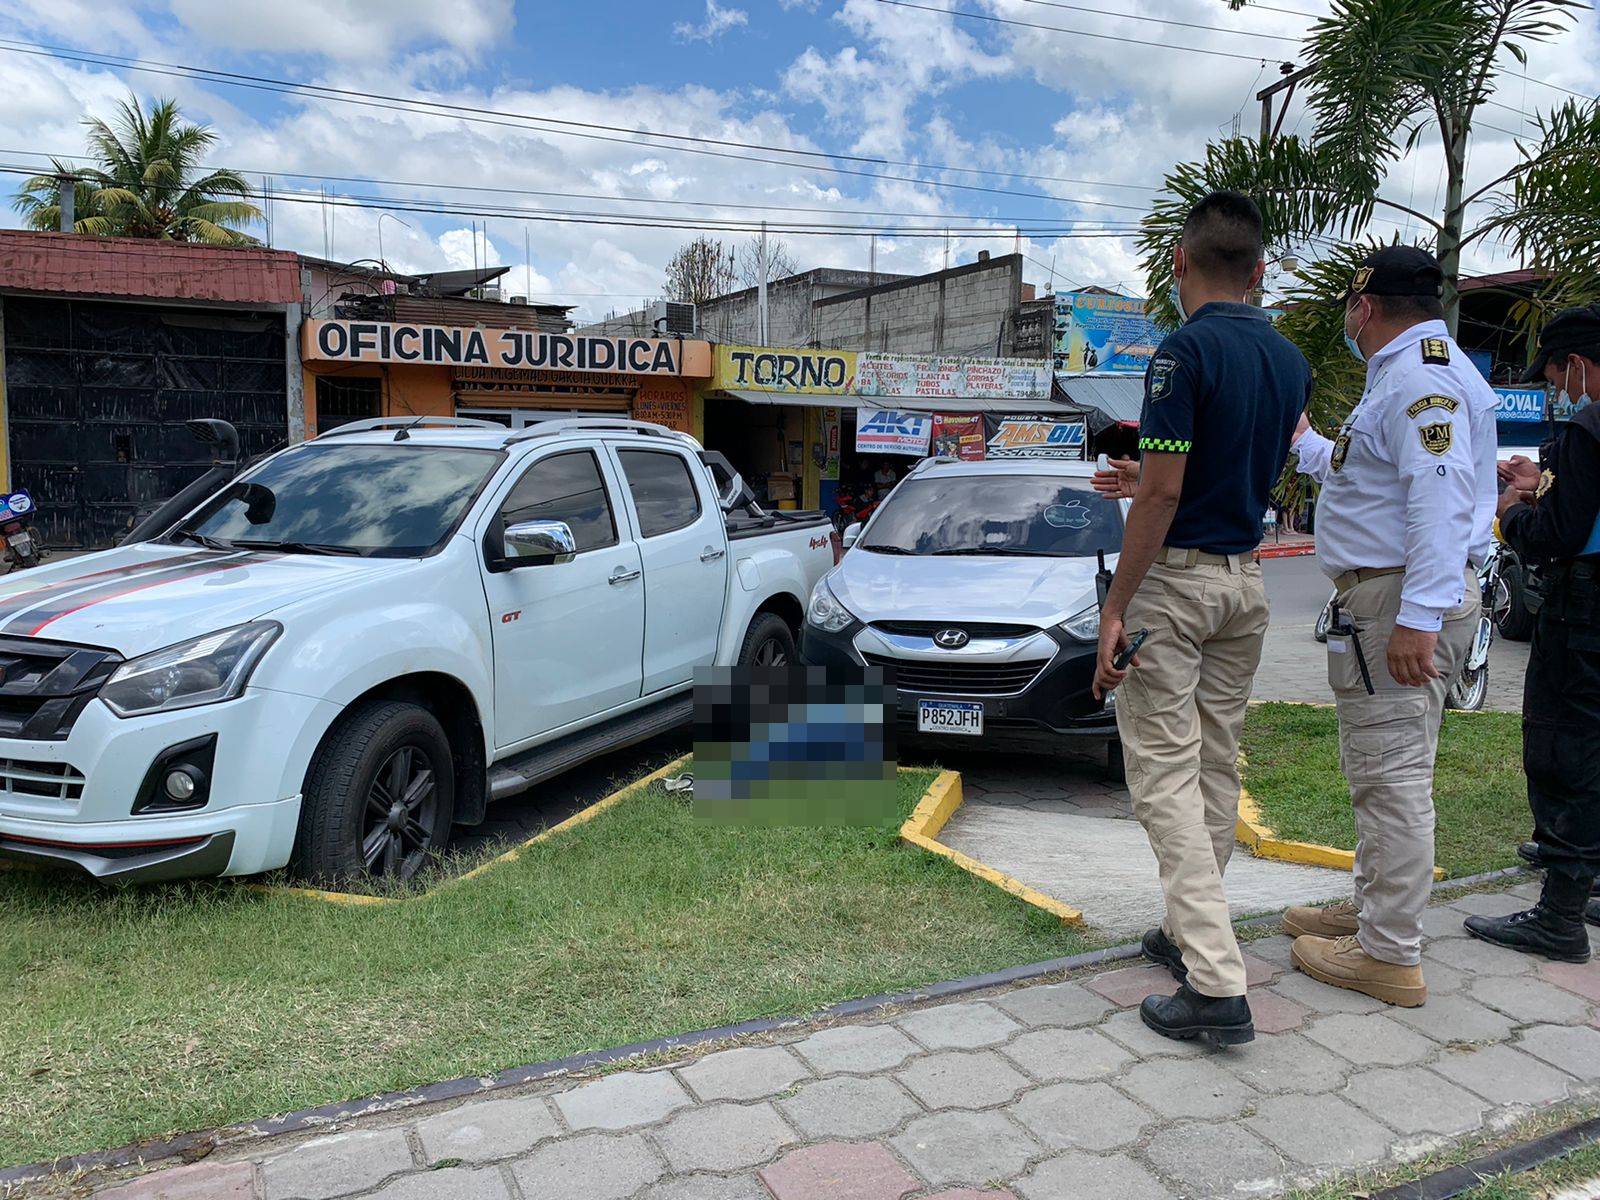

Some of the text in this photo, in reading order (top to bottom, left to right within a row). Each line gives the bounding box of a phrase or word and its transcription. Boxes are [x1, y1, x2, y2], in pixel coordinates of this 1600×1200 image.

[318, 322, 676, 373] OFICINA JURIDICA
[731, 352, 846, 389] TORNO
[861, 362, 894, 371] ACEITES
[966, 367, 1002, 375] PINCHAZO
[917, 373, 950, 381] LLANTAS
[966, 374, 994, 382] GORRAS
[917, 380, 941, 388] TUBOS
[966, 382, 1003, 390] PLAYERAS
[916, 387, 957, 396] PASTILLAS
[1495, 394, 1541, 411] DOVAL
[859, 411, 932, 436] AKT
[987, 421, 1085, 449] AMSOIL
[808, 535, 829, 550] 4x4
[501, 610, 521, 623] GT
[922, 708, 979, 727] P852JFH
